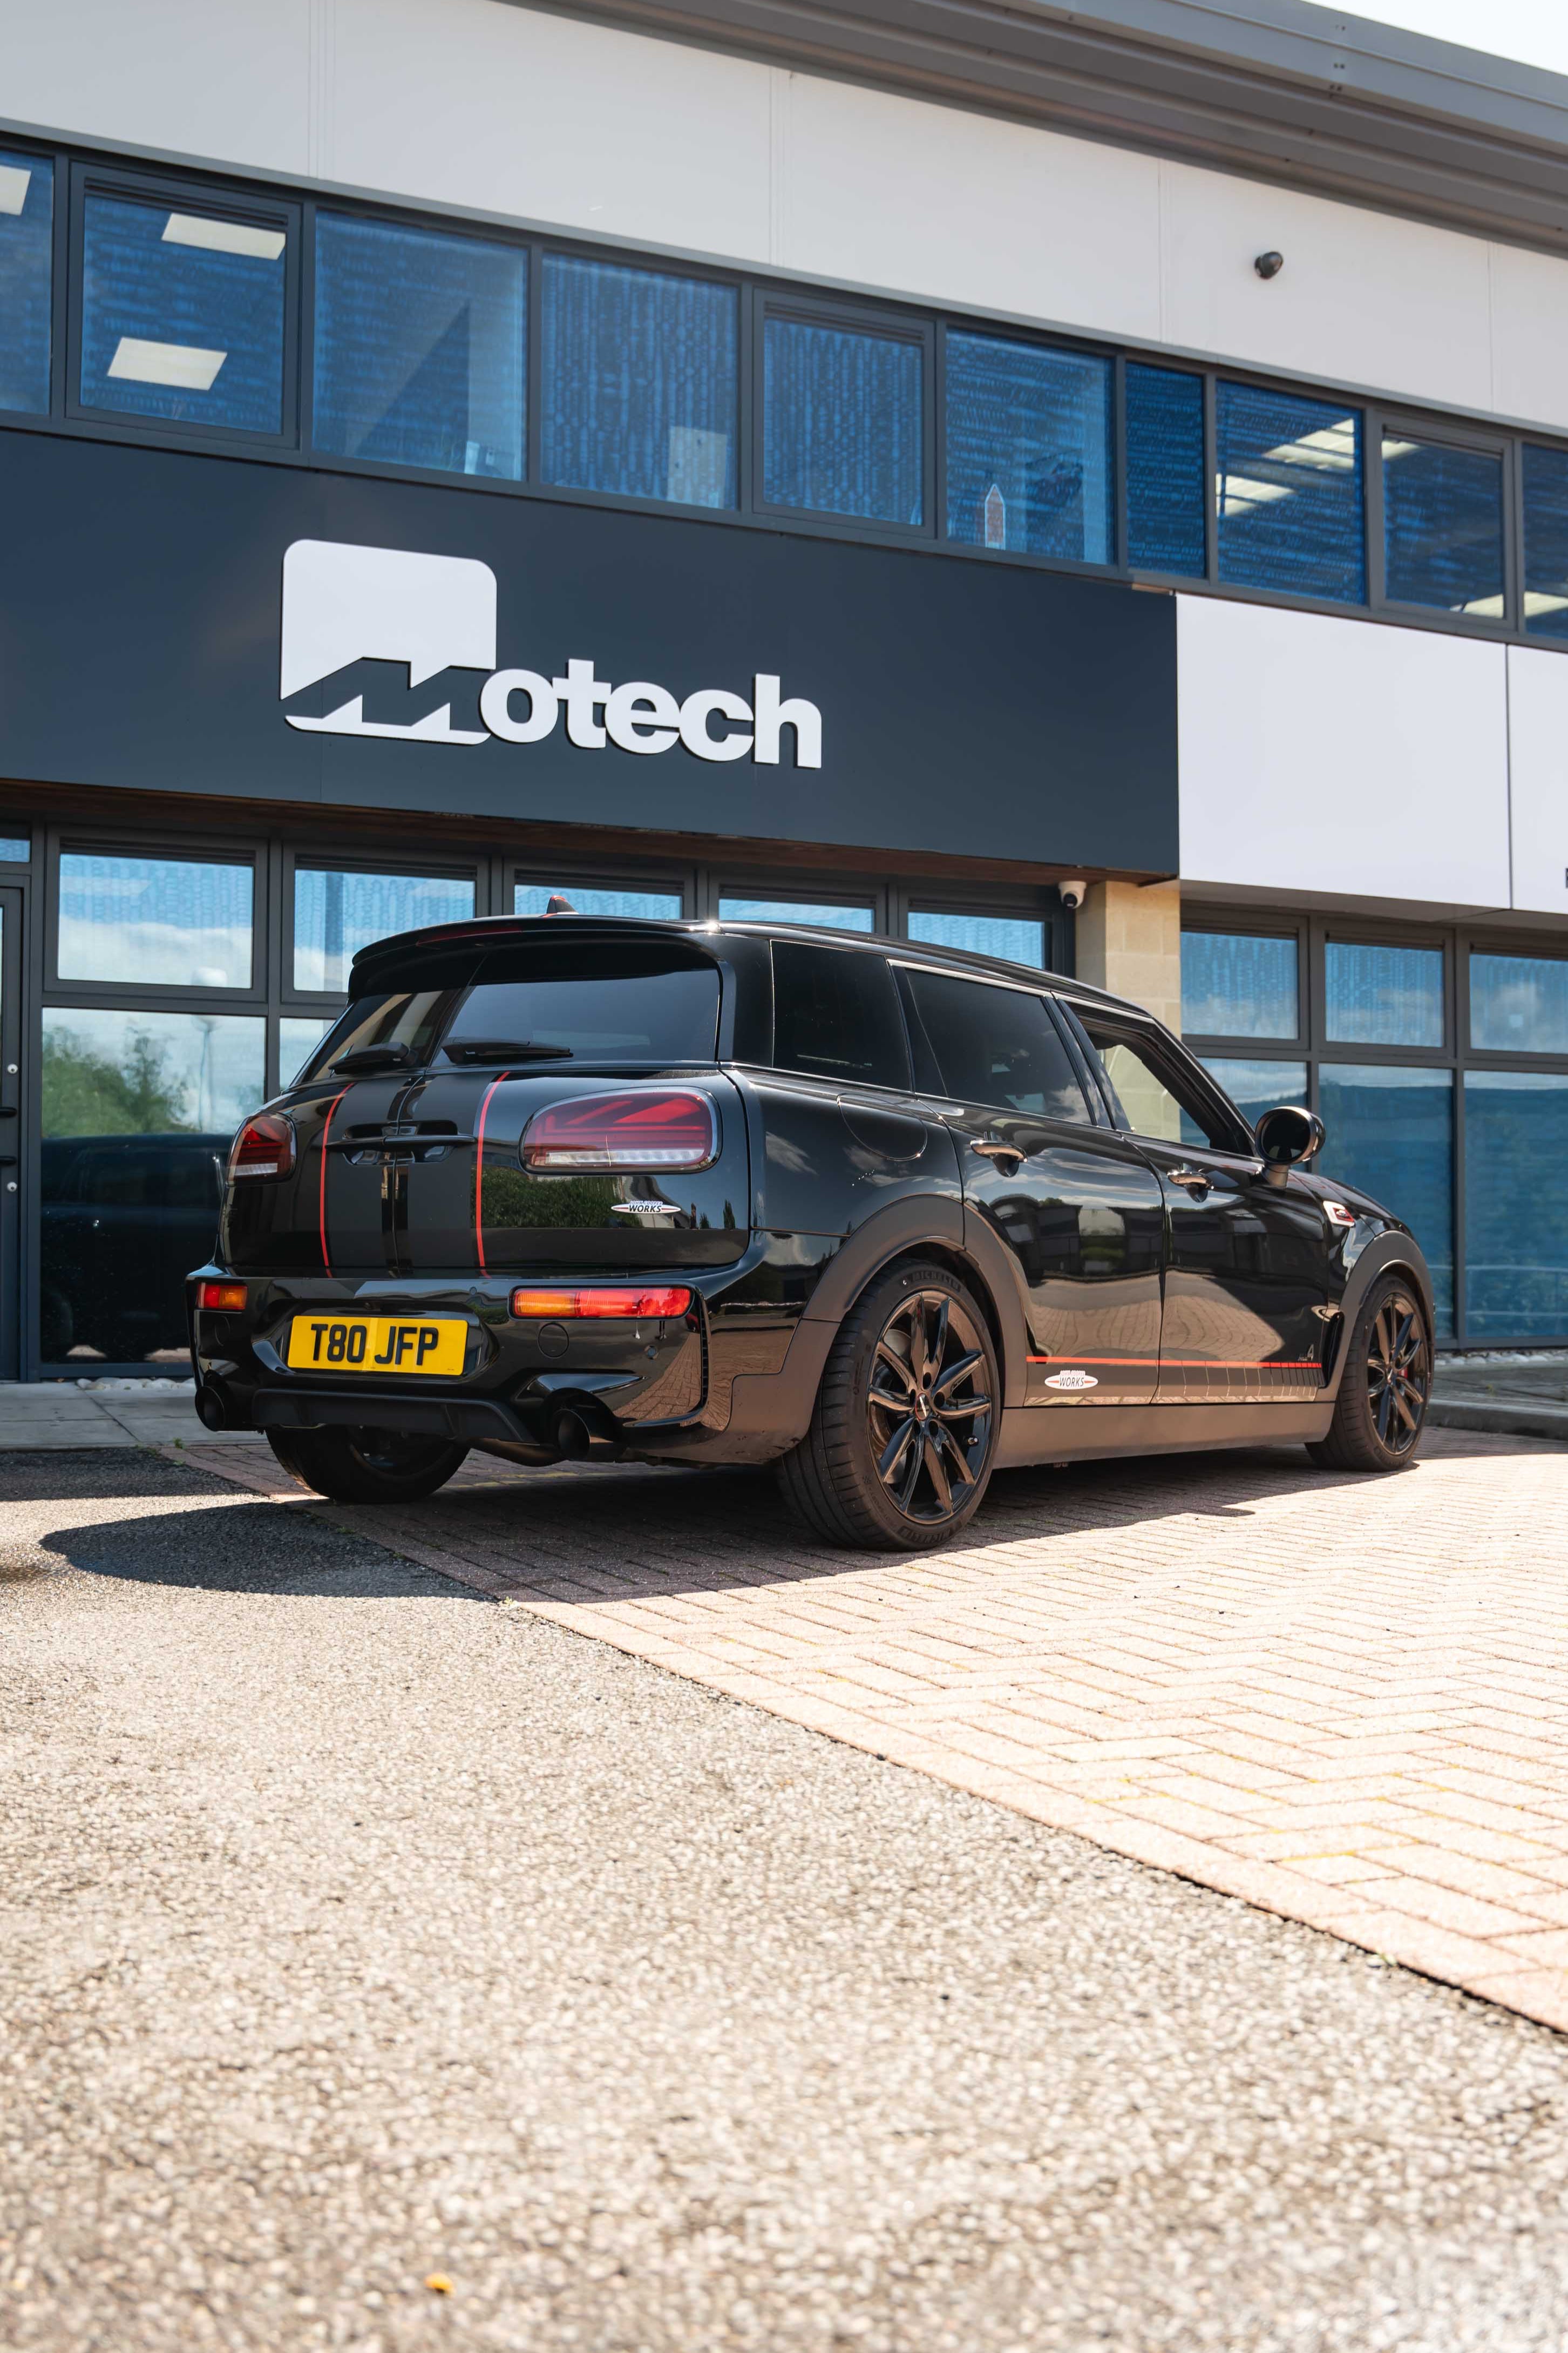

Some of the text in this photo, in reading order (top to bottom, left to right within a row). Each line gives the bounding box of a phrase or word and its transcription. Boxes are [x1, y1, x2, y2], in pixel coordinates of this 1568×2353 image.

[311, 1324, 439, 1366] T80 JFP
[1060, 1377, 1084, 1387] WORKS
